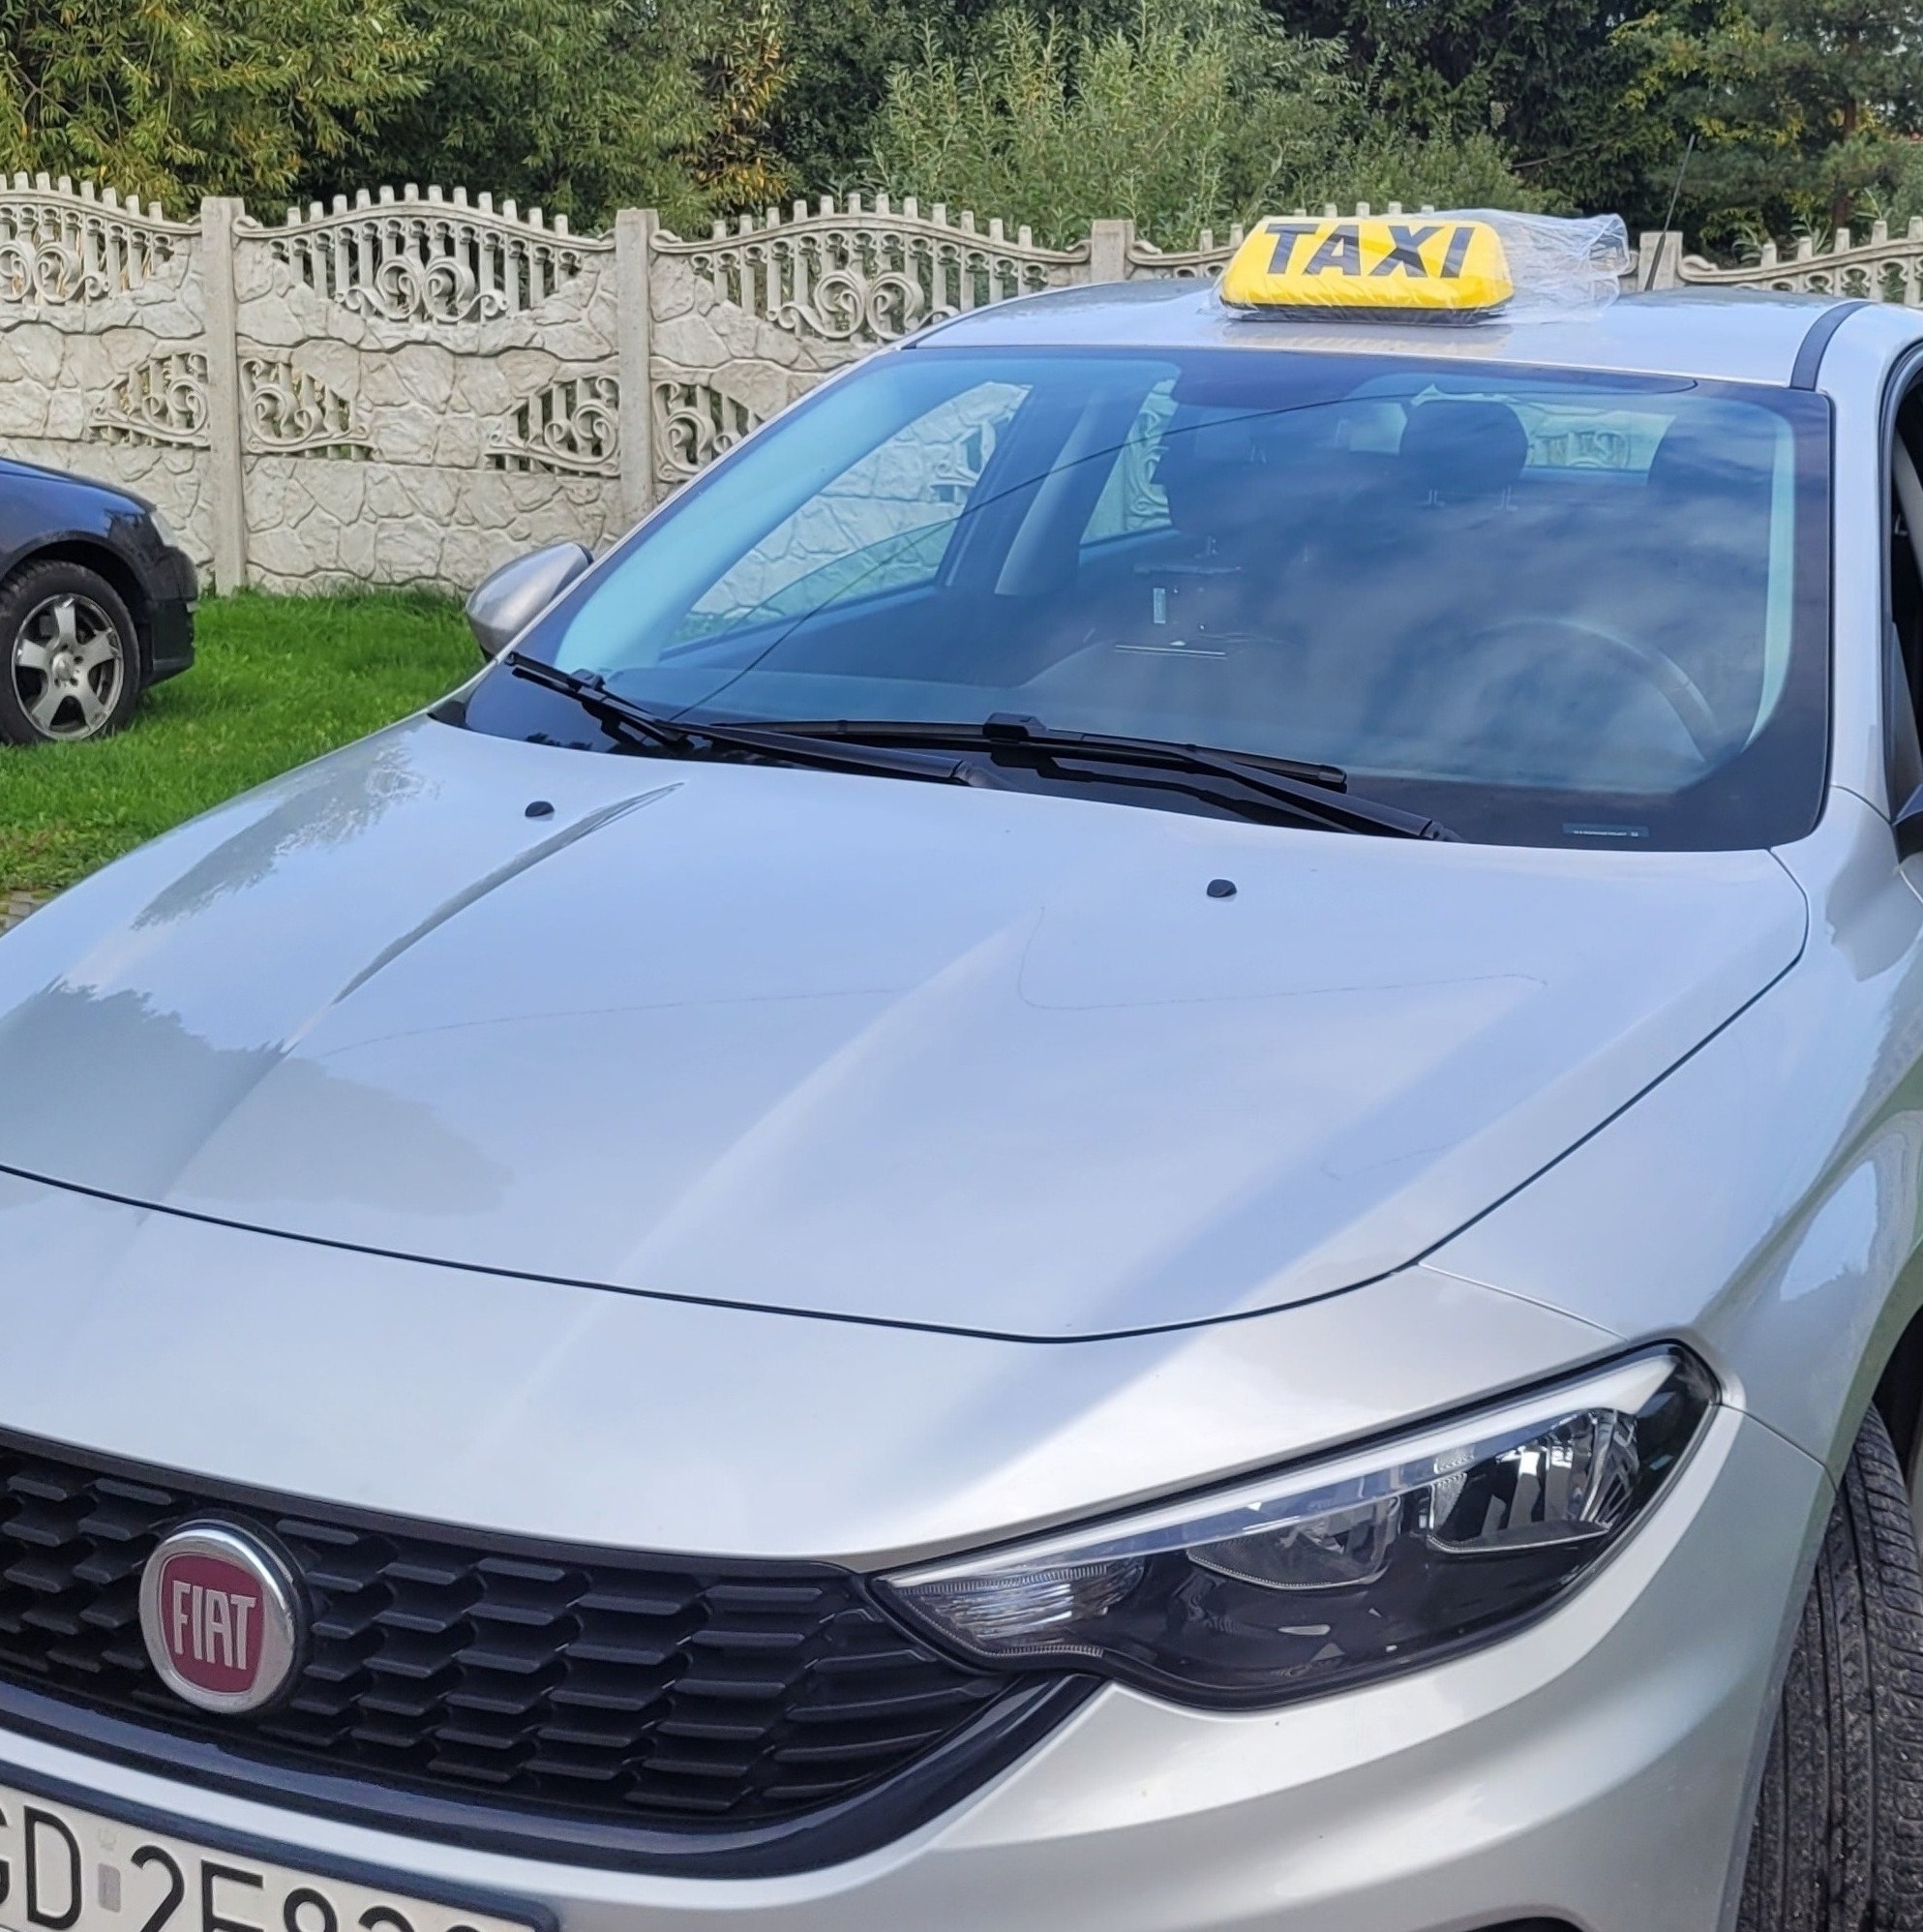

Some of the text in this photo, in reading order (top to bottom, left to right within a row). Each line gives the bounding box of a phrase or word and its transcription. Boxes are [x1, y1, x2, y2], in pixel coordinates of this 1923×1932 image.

[1265, 224, 1475, 279] TAXI
[172, 1580, 257, 1671] FIAT
[0, 1804, 82, 1930] D
